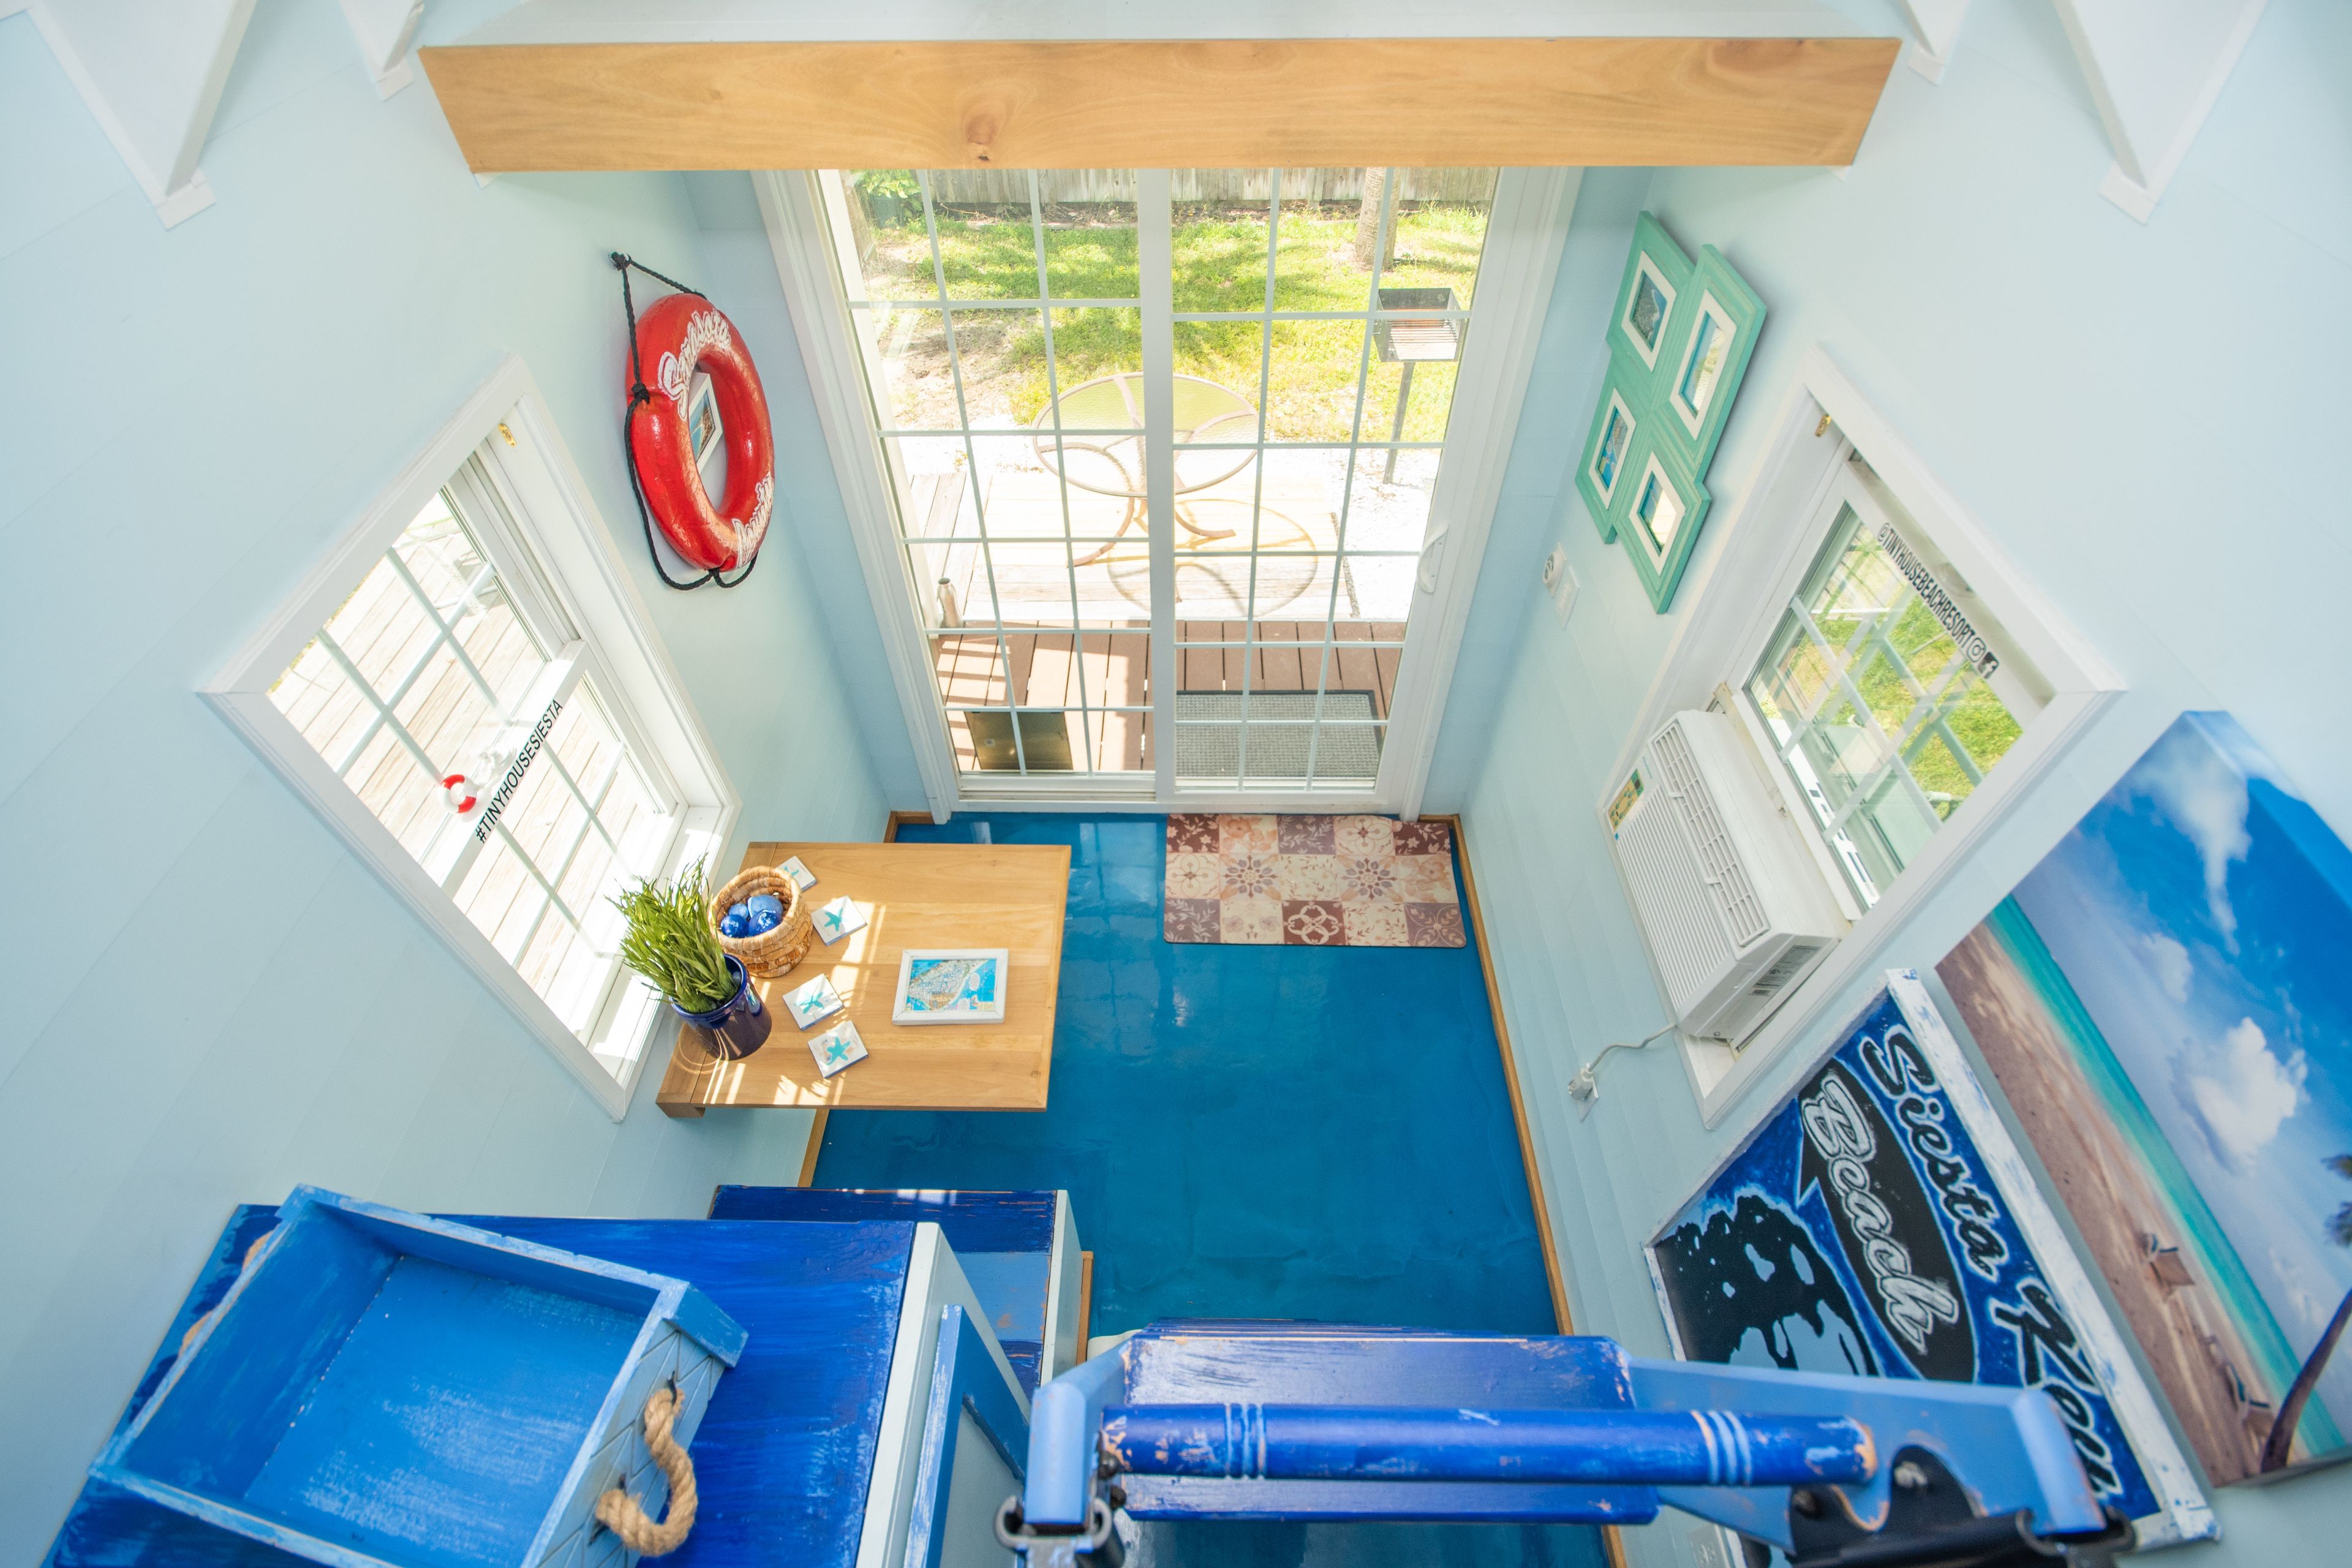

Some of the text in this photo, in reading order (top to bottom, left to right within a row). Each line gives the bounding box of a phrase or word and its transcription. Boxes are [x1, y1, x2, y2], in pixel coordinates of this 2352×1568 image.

[658, 309, 731, 421] Sarasota
[475, 699, 563, 843] #TINYHOUSESIESTA
[1802, 1074, 1960, 1351] Beach
[1858, 1023, 2010, 1284] Siesta
